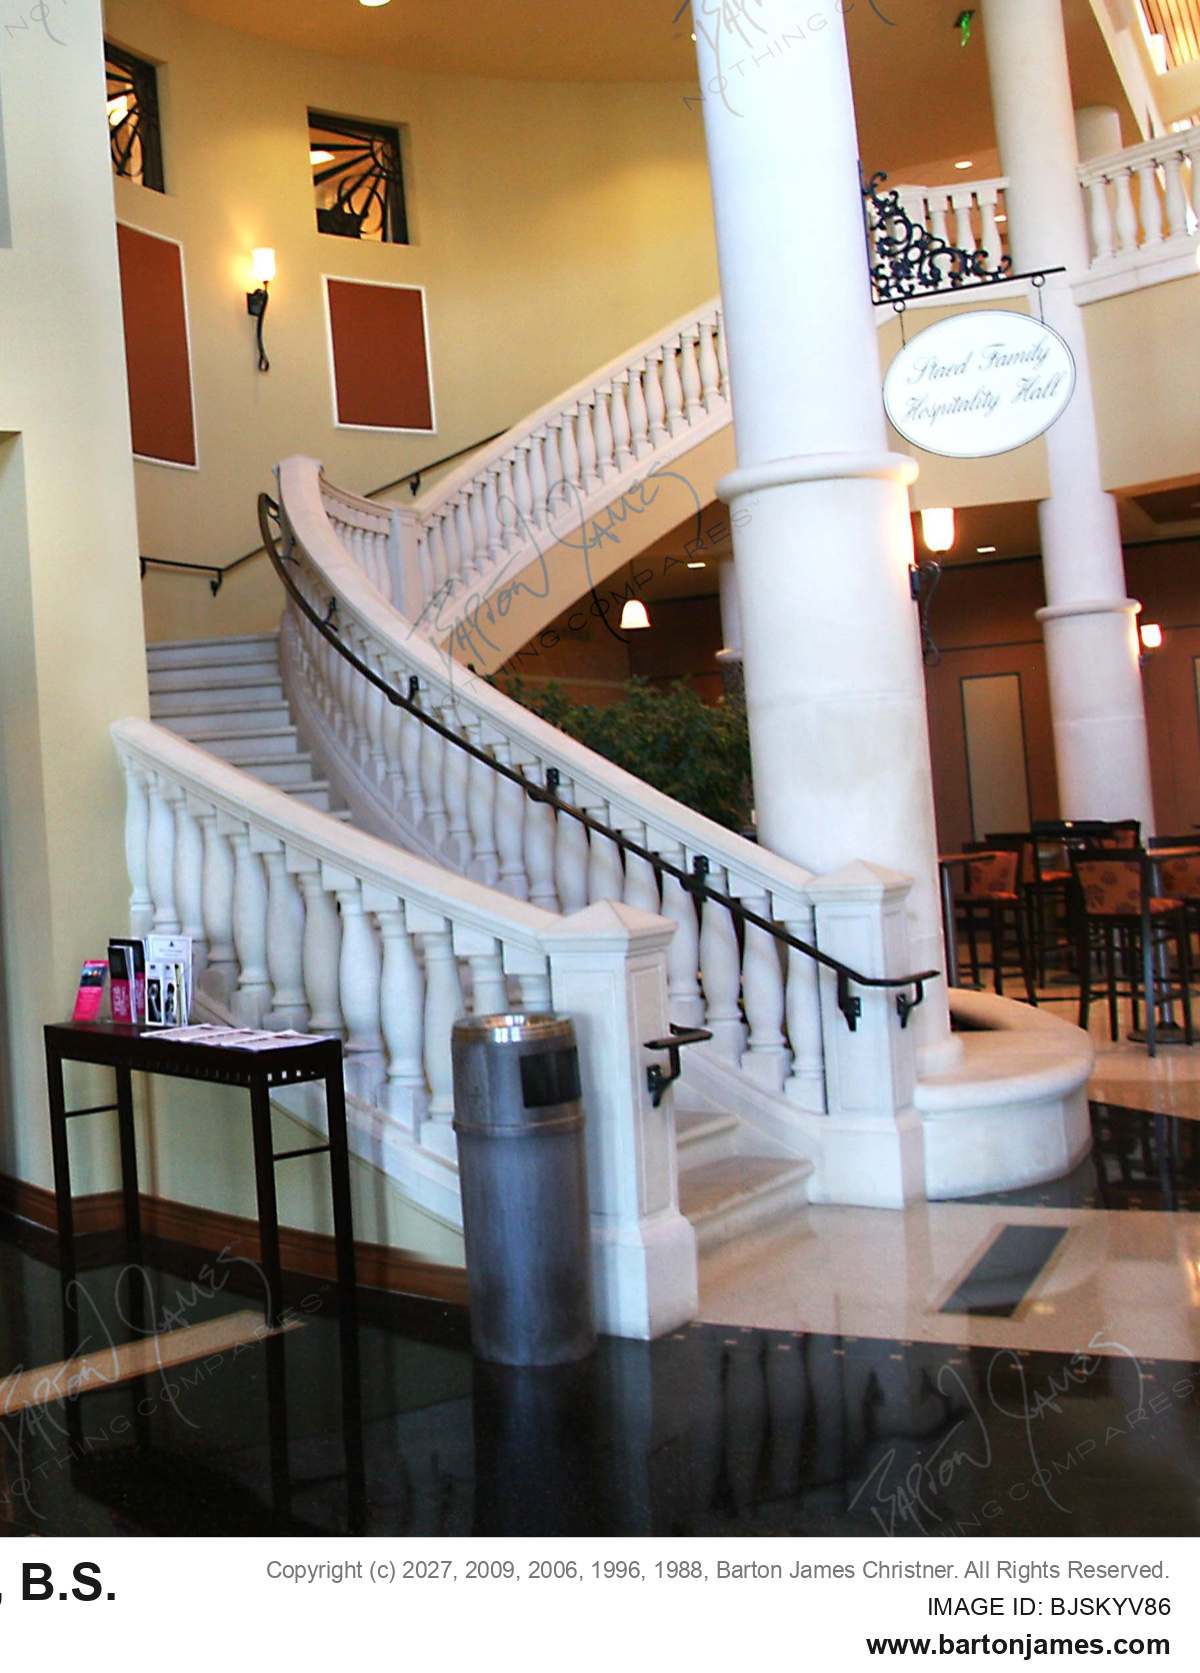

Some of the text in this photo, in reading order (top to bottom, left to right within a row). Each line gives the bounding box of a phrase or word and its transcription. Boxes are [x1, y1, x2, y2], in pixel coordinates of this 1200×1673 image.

[977, 335, 1051, 372] Family
[901, 370, 1068, 428] Hospitality Hall
